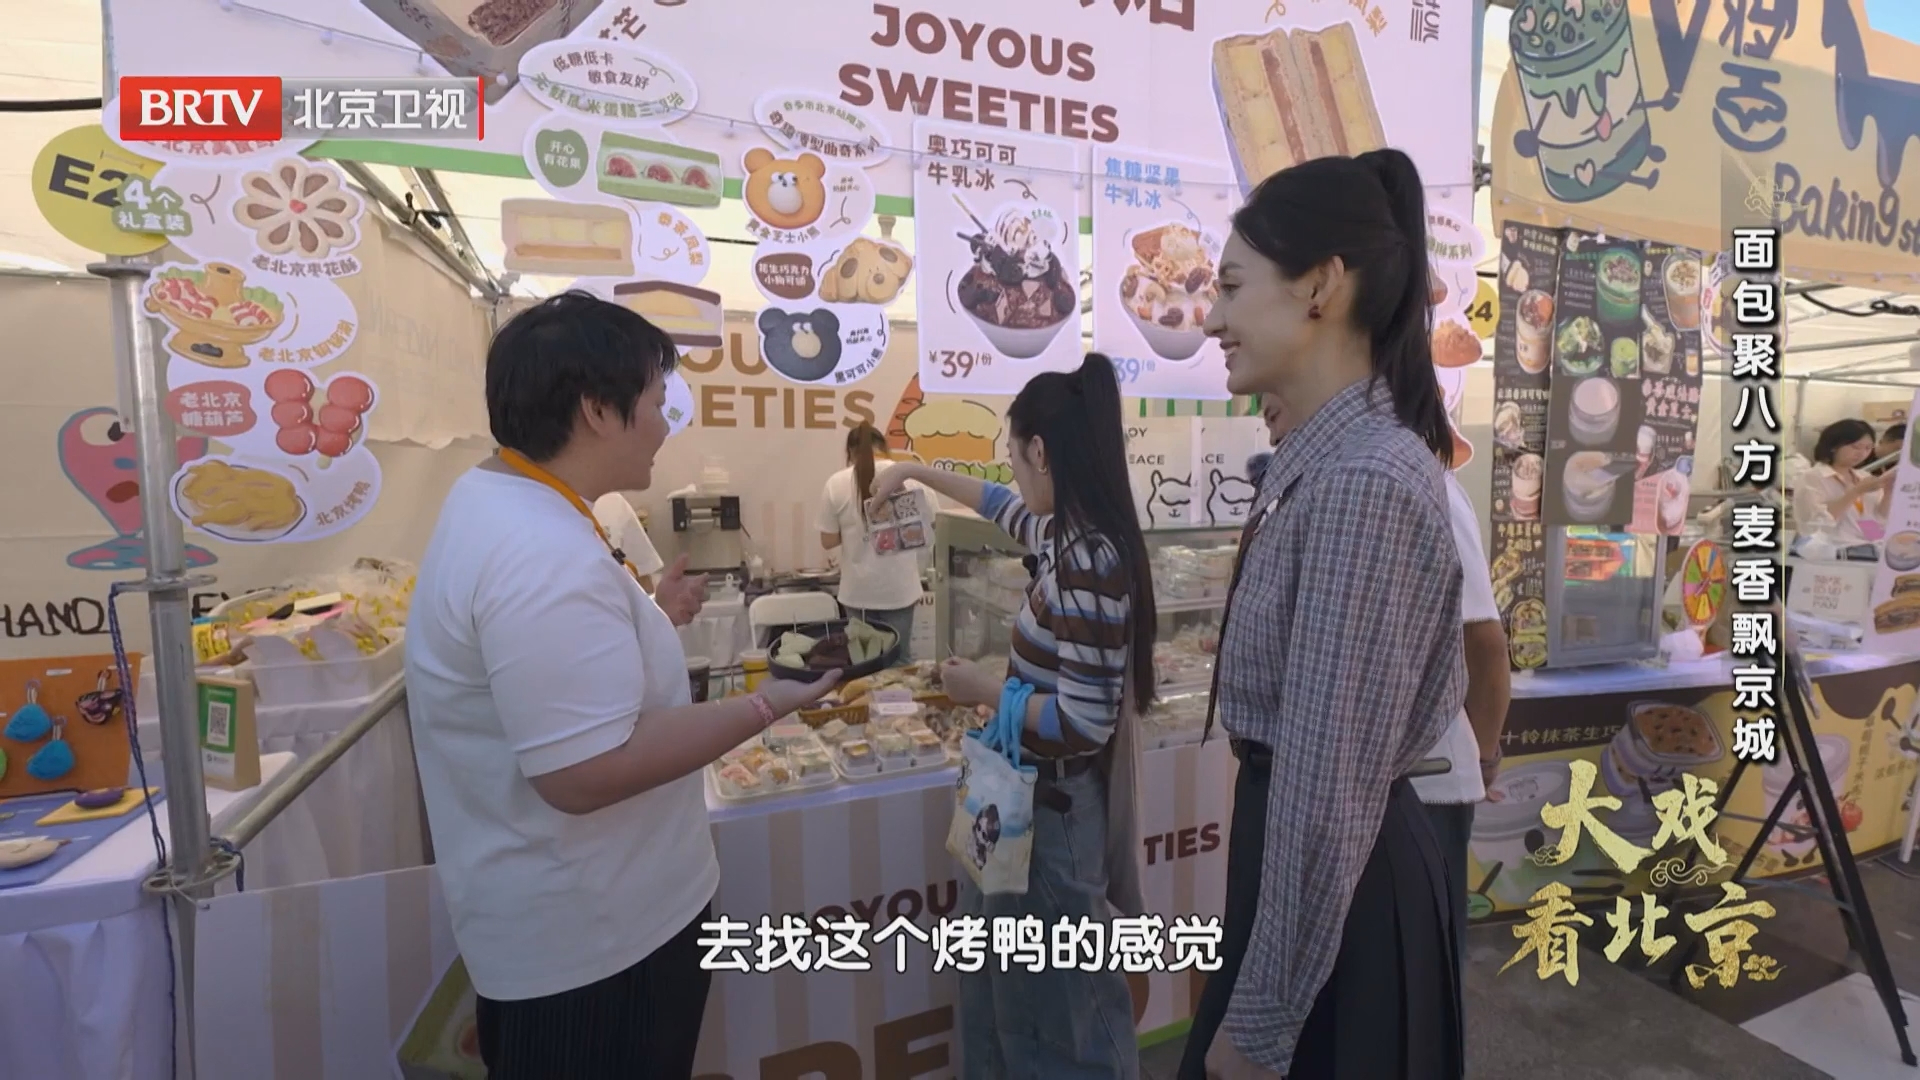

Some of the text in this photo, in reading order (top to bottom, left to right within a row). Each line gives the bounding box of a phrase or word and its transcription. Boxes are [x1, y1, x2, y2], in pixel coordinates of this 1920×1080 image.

[871, 3, 1096, 82] JOYOUS
[553, 50, 614, 73] 低糖低卡
[588, 70, 650, 91] 敏食友好
[838, 63, 1120, 143] SWEETIES
[550, 139, 575, 155] 开心
[928, 134, 1017, 166] 奥巧可可
[928, 162, 996, 191] 牛乳冰
[1105, 157, 1180, 187] 焦糖坚果
[124, 179, 177, 210] 4个
[1104, 183, 1162, 210] 牛乳冰
[1772, 162, 1901, 248] Baking
[118, 211, 186, 231] 礼盒装
[180, 391, 242, 409] 老北京
[182, 410, 244, 428] 糖葫芦
[1143, 822, 1221, 866] TIES
